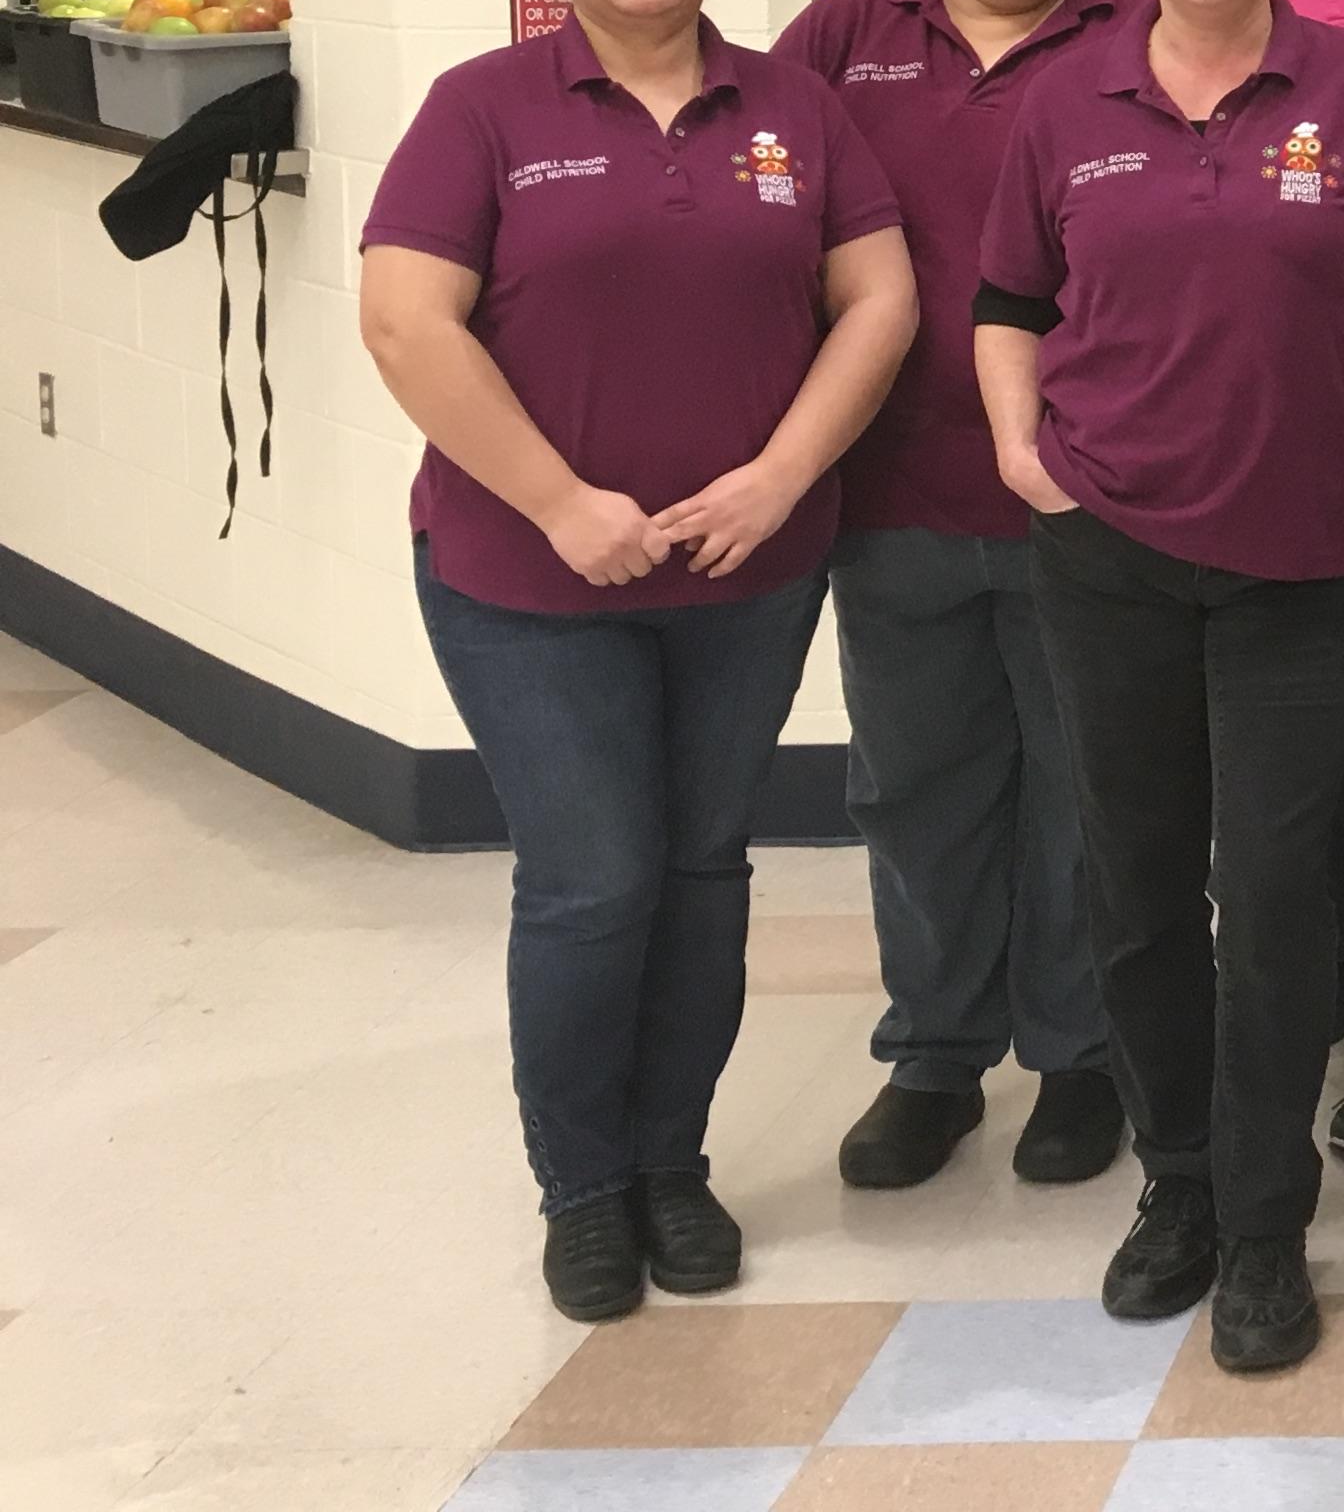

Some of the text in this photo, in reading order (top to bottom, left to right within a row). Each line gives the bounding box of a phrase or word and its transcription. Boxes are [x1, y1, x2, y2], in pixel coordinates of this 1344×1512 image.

[525, 8, 544, 21] OR
[1108, 152, 1151, 164] SCHOOL
[508, 155, 610, 182] CALDWELL SCHOOL
[1093, 162, 1143, 179] NUTRITION
[515, 165, 606, 190] CHILD NUTRITION
[1281, 169, 1321, 185] WHOO'S
[1280, 182, 1322, 196] HUNGRY
